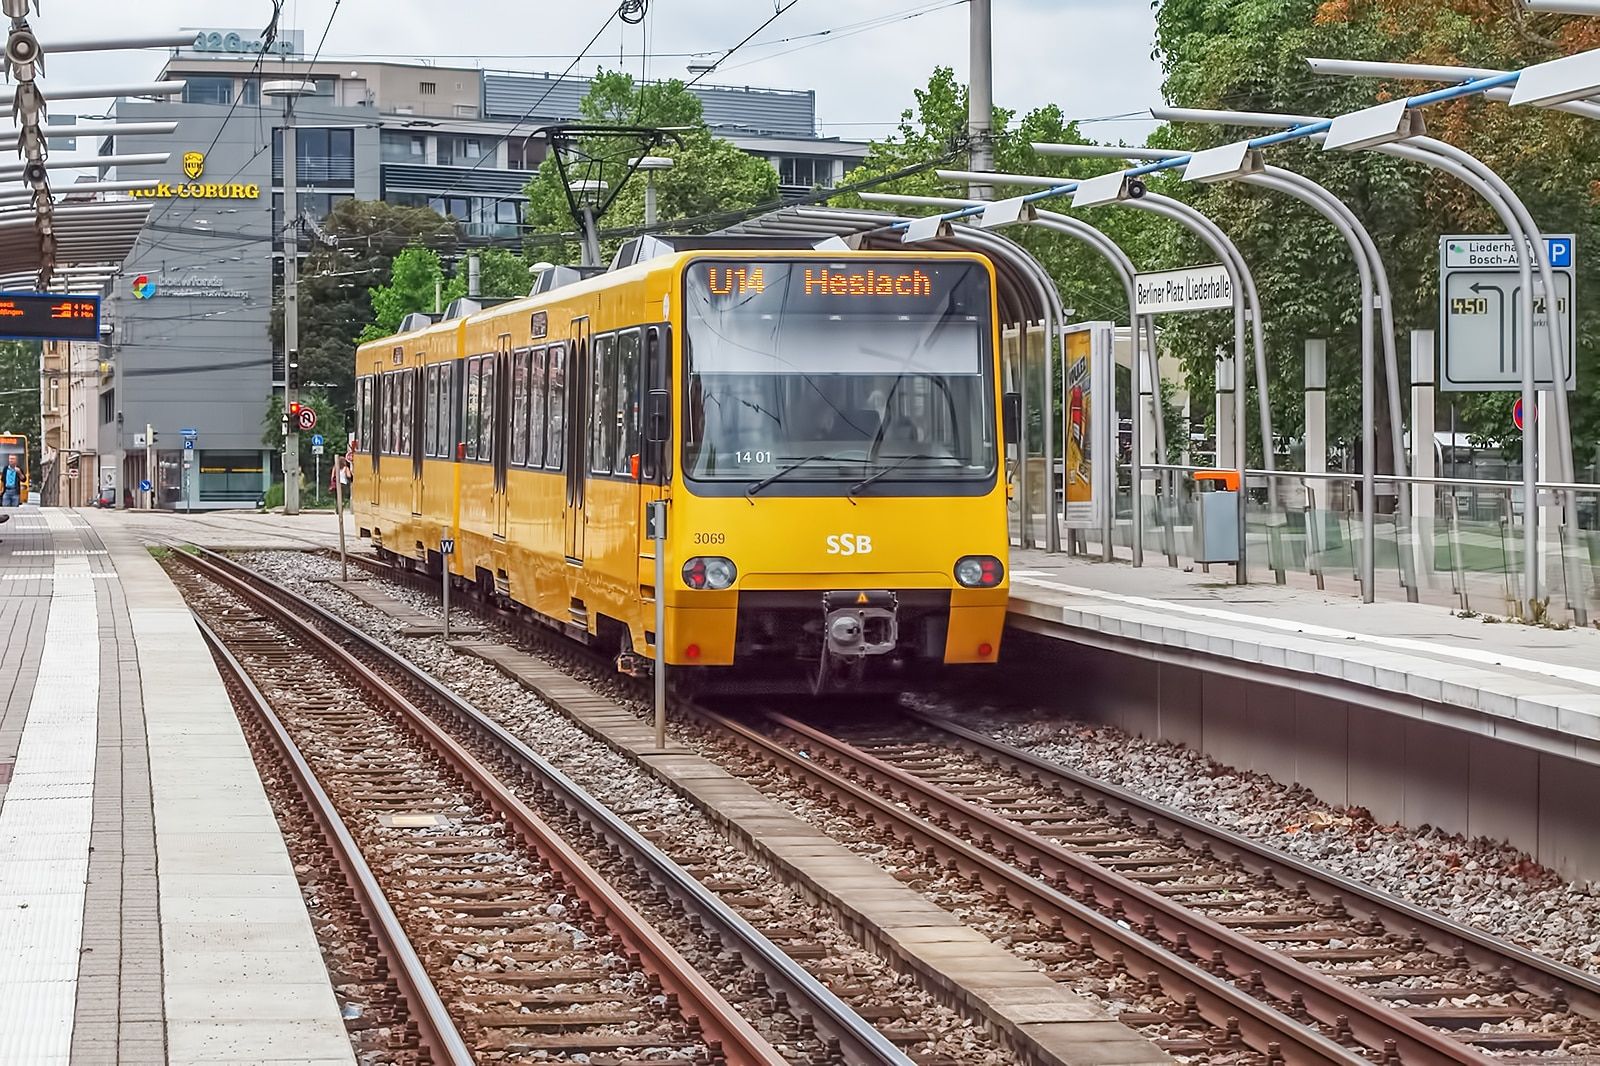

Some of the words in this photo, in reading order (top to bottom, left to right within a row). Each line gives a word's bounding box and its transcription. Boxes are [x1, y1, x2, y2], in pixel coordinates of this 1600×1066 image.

[1469, 242, 1531, 252] Liederha
[1552, 243, 1566, 262] P
[1469, 255, 1538, 264] Bosch-Aal
[709, 268, 765, 294] U14
[805, 269, 931, 295] Heslach
[1137, 281, 1165, 305] Berliner
[1166, 279, 1185, 303] Platz
[1185, 274, 1233, 304] (Liederhalle)
[1452, 298, 1487, 314] 450
[736, 451, 752, 463] 14
[756, 451, 771, 463] 01
[694, 532, 725, 544] 3069
[826, 533, 873, 556] SSB
[441, 541, 453, 552] W
